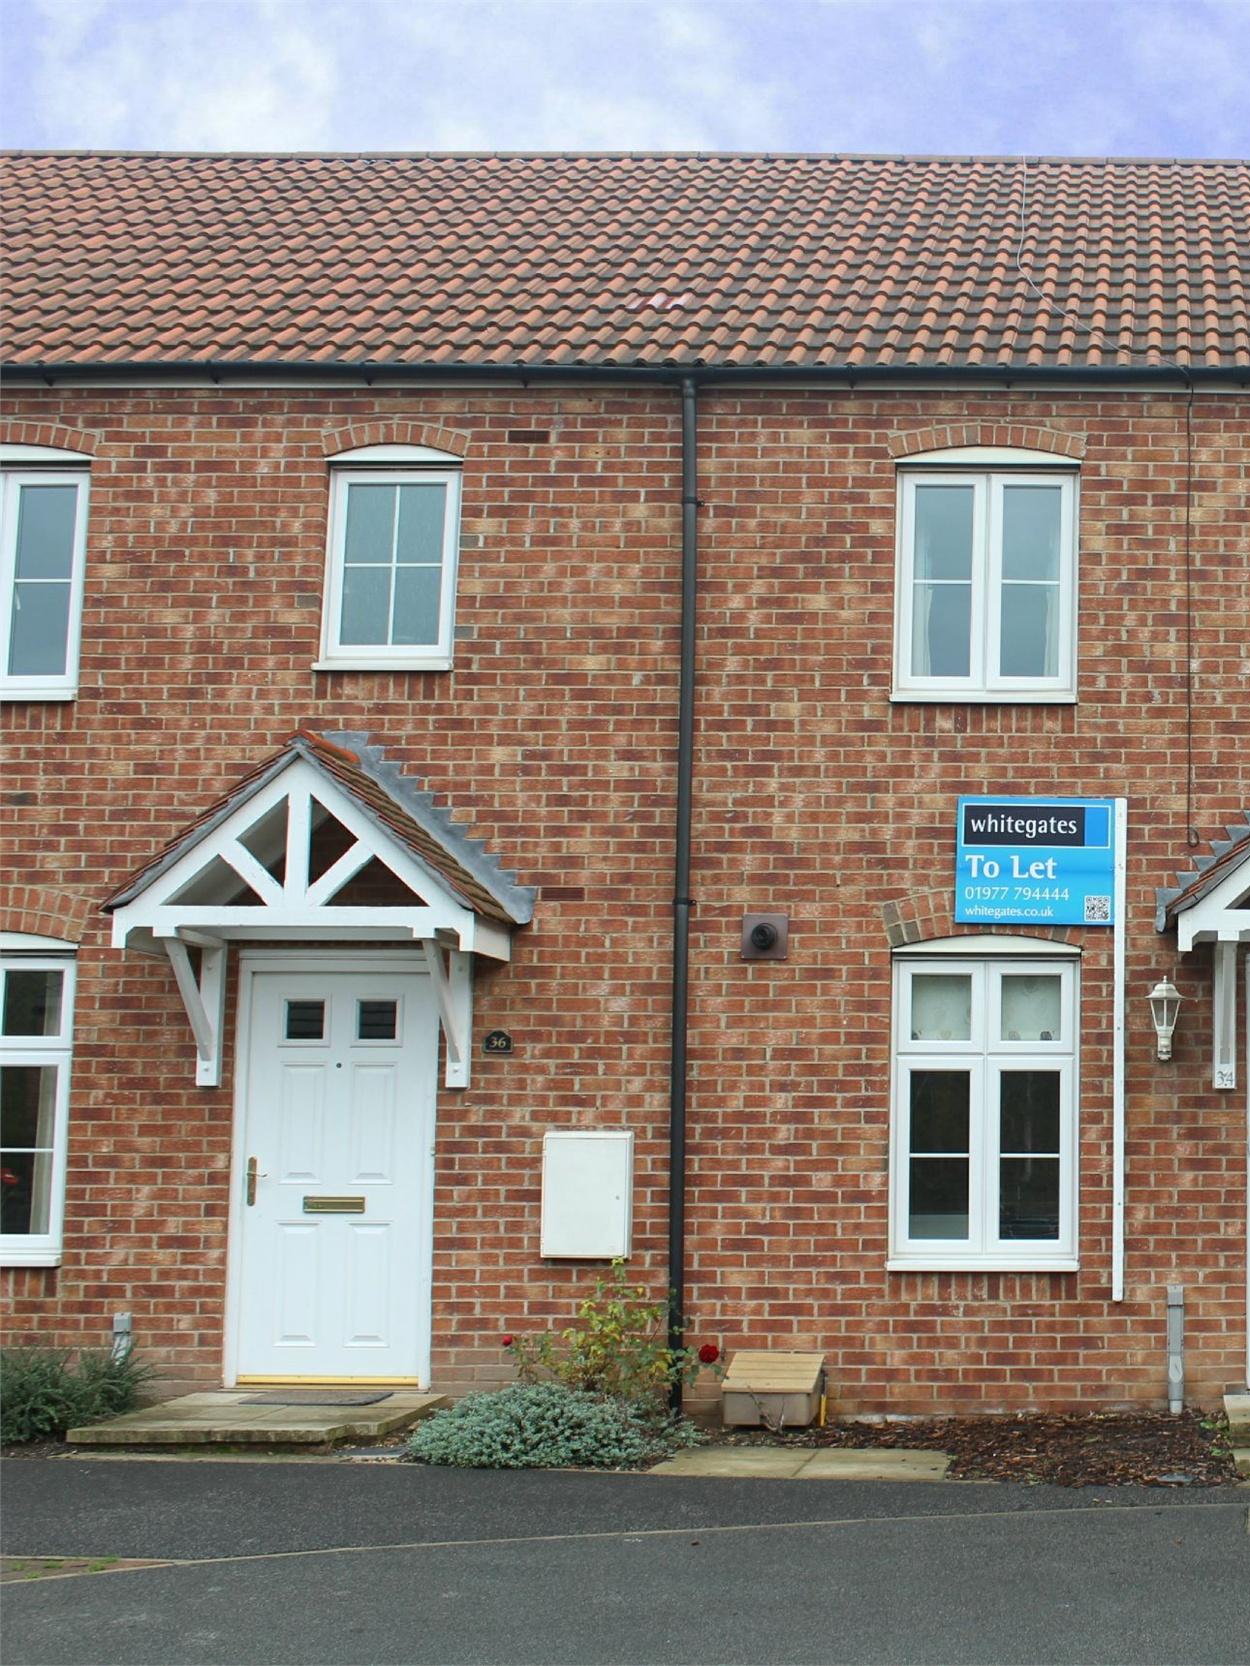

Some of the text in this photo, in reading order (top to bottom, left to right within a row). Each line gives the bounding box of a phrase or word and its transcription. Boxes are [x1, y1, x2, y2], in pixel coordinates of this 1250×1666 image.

[971, 814, 1078, 838] whitegates
[965, 854, 1057, 879] To Let
[964, 886, 1070, 901] 01977 794444
[965, 904, 1054, 919] whitegates.co.uk
[489, 1037, 506, 1048] 36
[1217, 1071, 1233, 1086] 34
